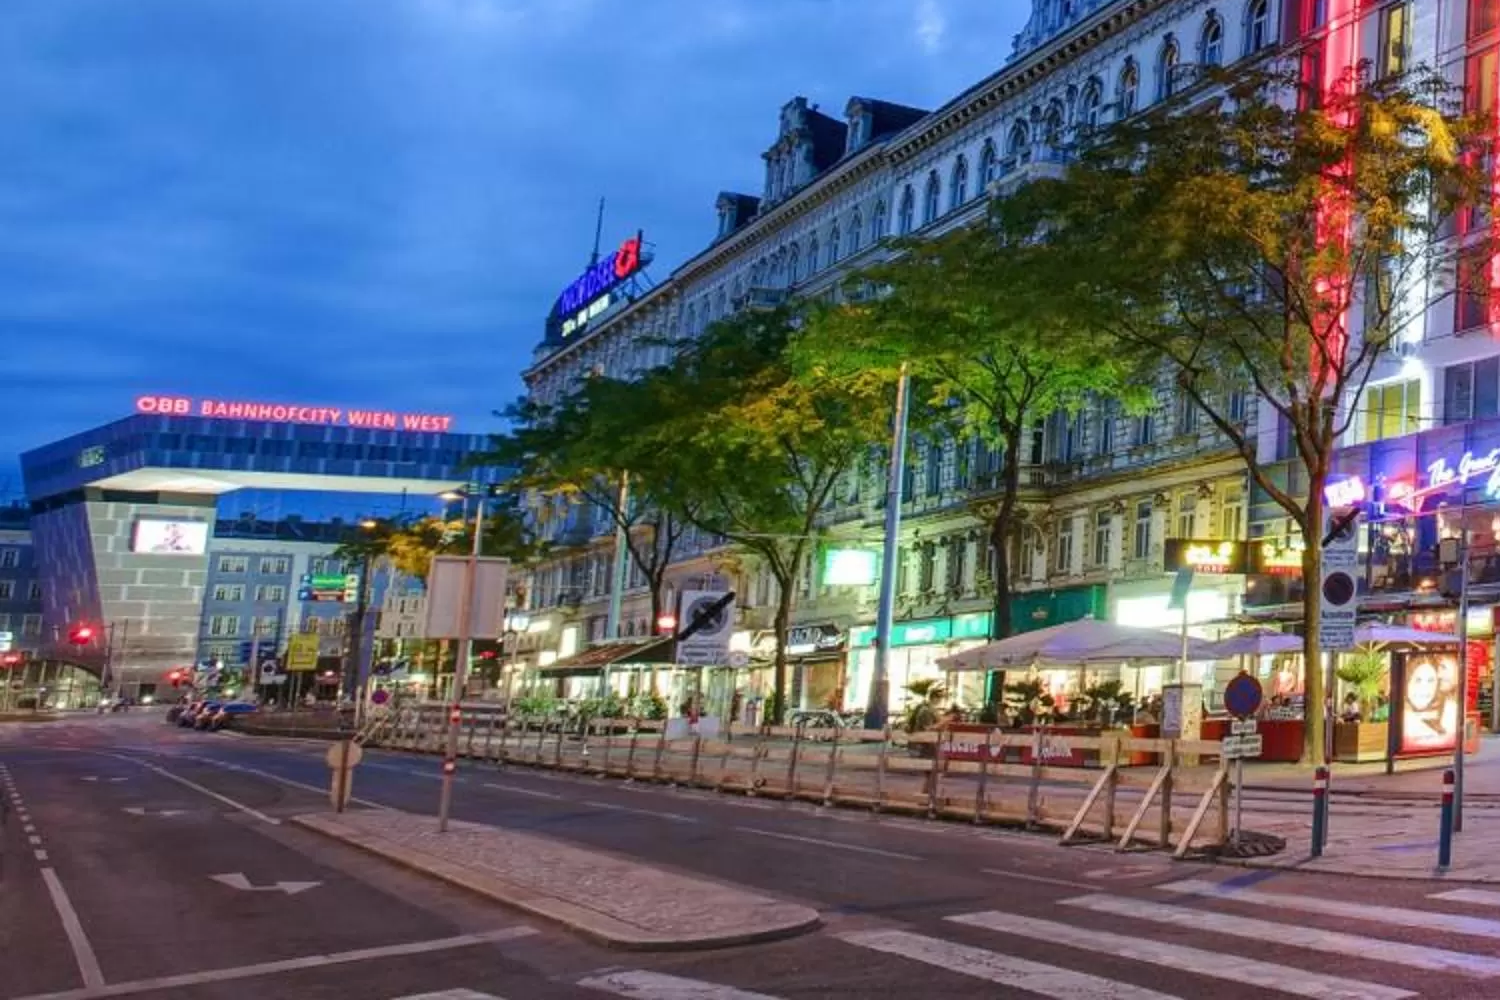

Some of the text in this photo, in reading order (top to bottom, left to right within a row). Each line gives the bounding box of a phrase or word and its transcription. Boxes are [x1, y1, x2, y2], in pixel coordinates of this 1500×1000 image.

[201, 401, 341, 426] BAHNHOFCITY
[347, 410, 396, 428] WIEN
[403, 414, 452, 432] WEST
